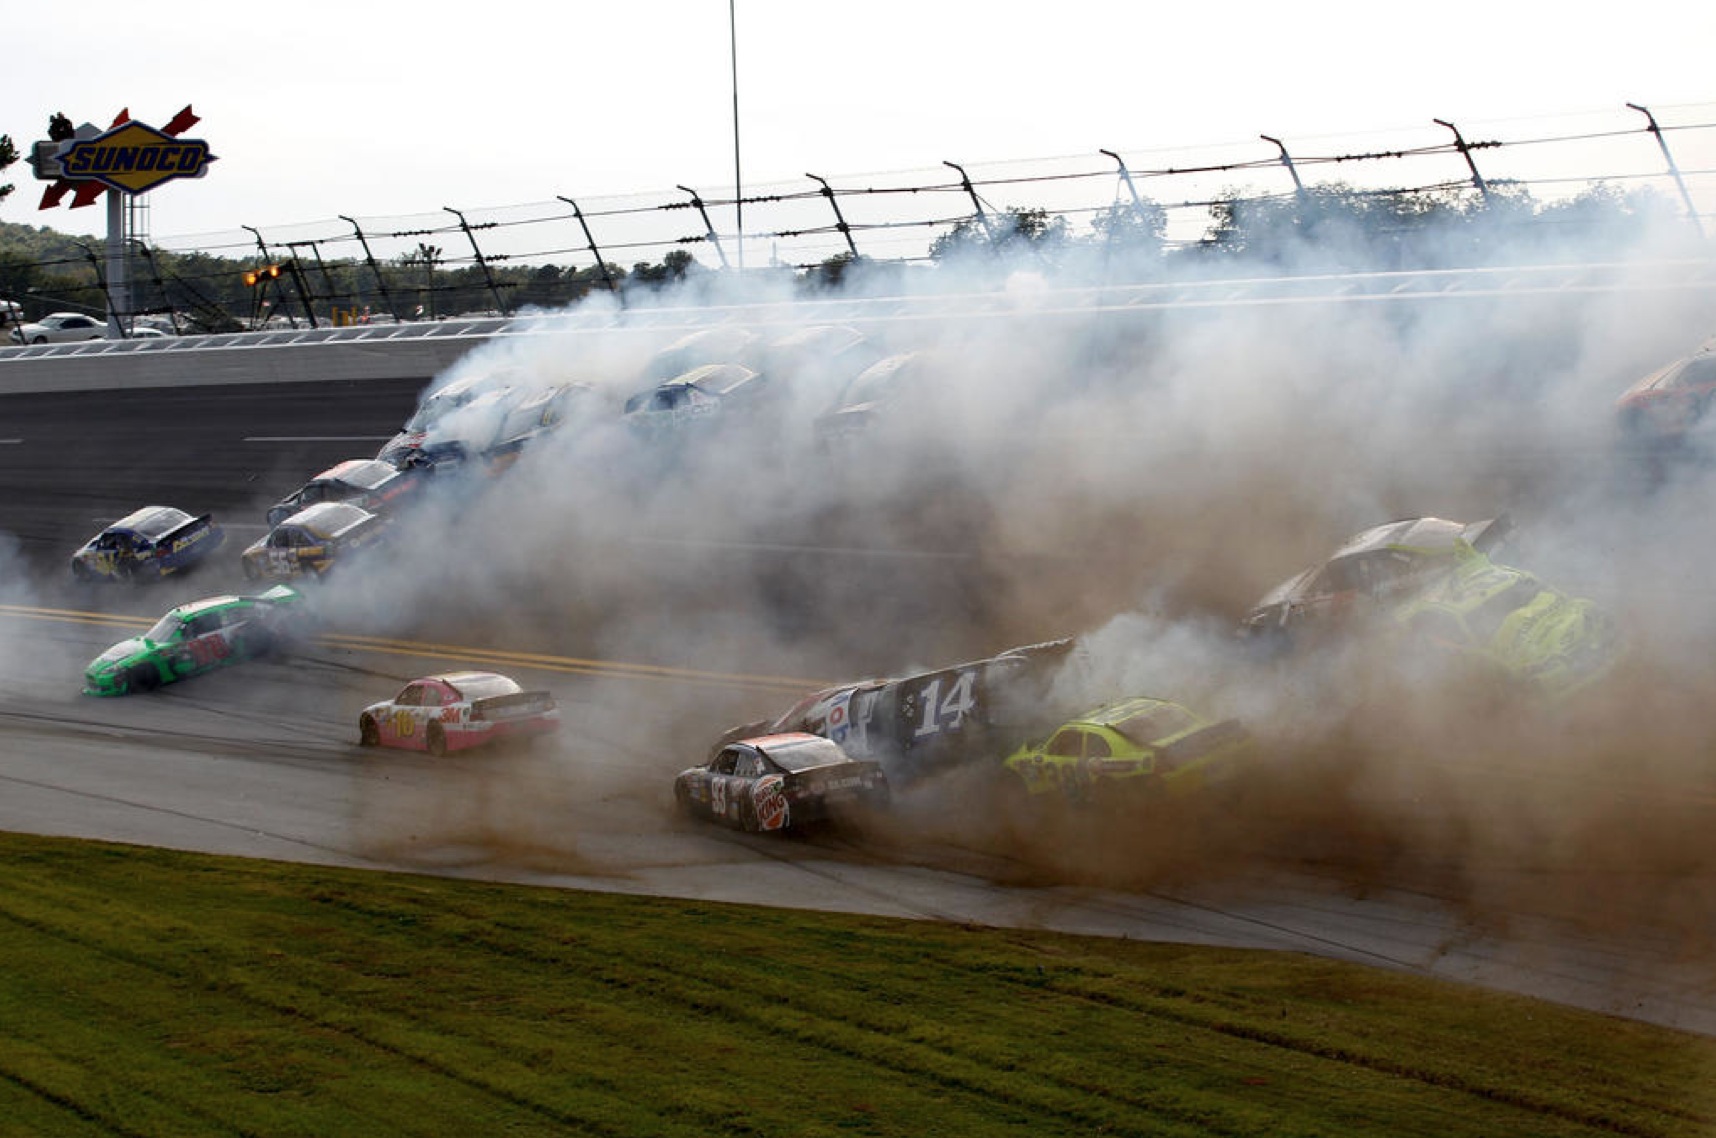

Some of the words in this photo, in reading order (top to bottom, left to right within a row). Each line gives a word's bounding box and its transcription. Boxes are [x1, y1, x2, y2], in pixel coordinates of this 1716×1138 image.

[71, 146, 202, 171] SUNOCO
[914, 671, 976, 737] 14
[758, 793, 785, 820] KING
